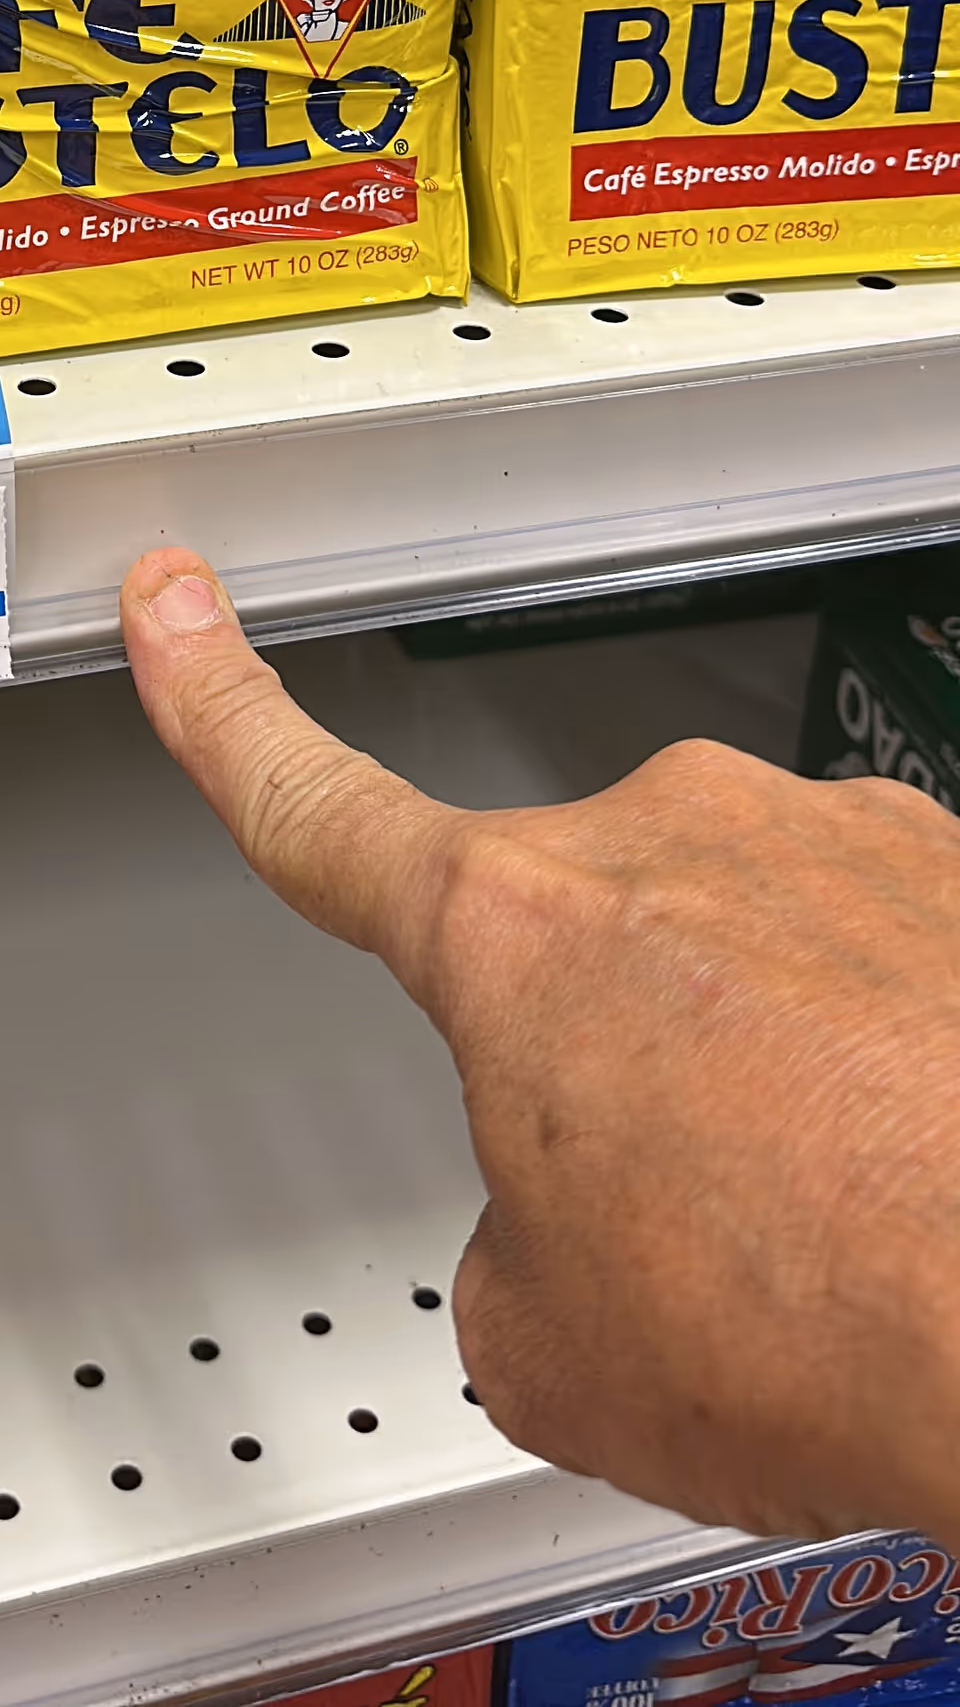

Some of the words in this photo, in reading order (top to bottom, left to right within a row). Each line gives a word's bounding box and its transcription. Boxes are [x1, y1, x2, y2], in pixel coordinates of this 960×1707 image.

[583, 166, 646, 195] Café
[654, 163, 769, 190] Espresso
[777, 153, 876, 180] Molido
[208, 197, 310, 230] Ground
[320, 183, 405, 213] Coffee
[567, 234, 630, 257] PESO
[636, 228, 699, 251] NETO
[706, 227, 729, 247] 10
[735, 224, 769, 243] OZ
[775, 218, 839, 244] (283g)
[191, 265, 237, 289] NET
[243, 259, 280, 280] WT
[287, 255, 311, 276] 10
[318, 249, 349, 270] OZ
[355, 240, 420, 269] (283g)
